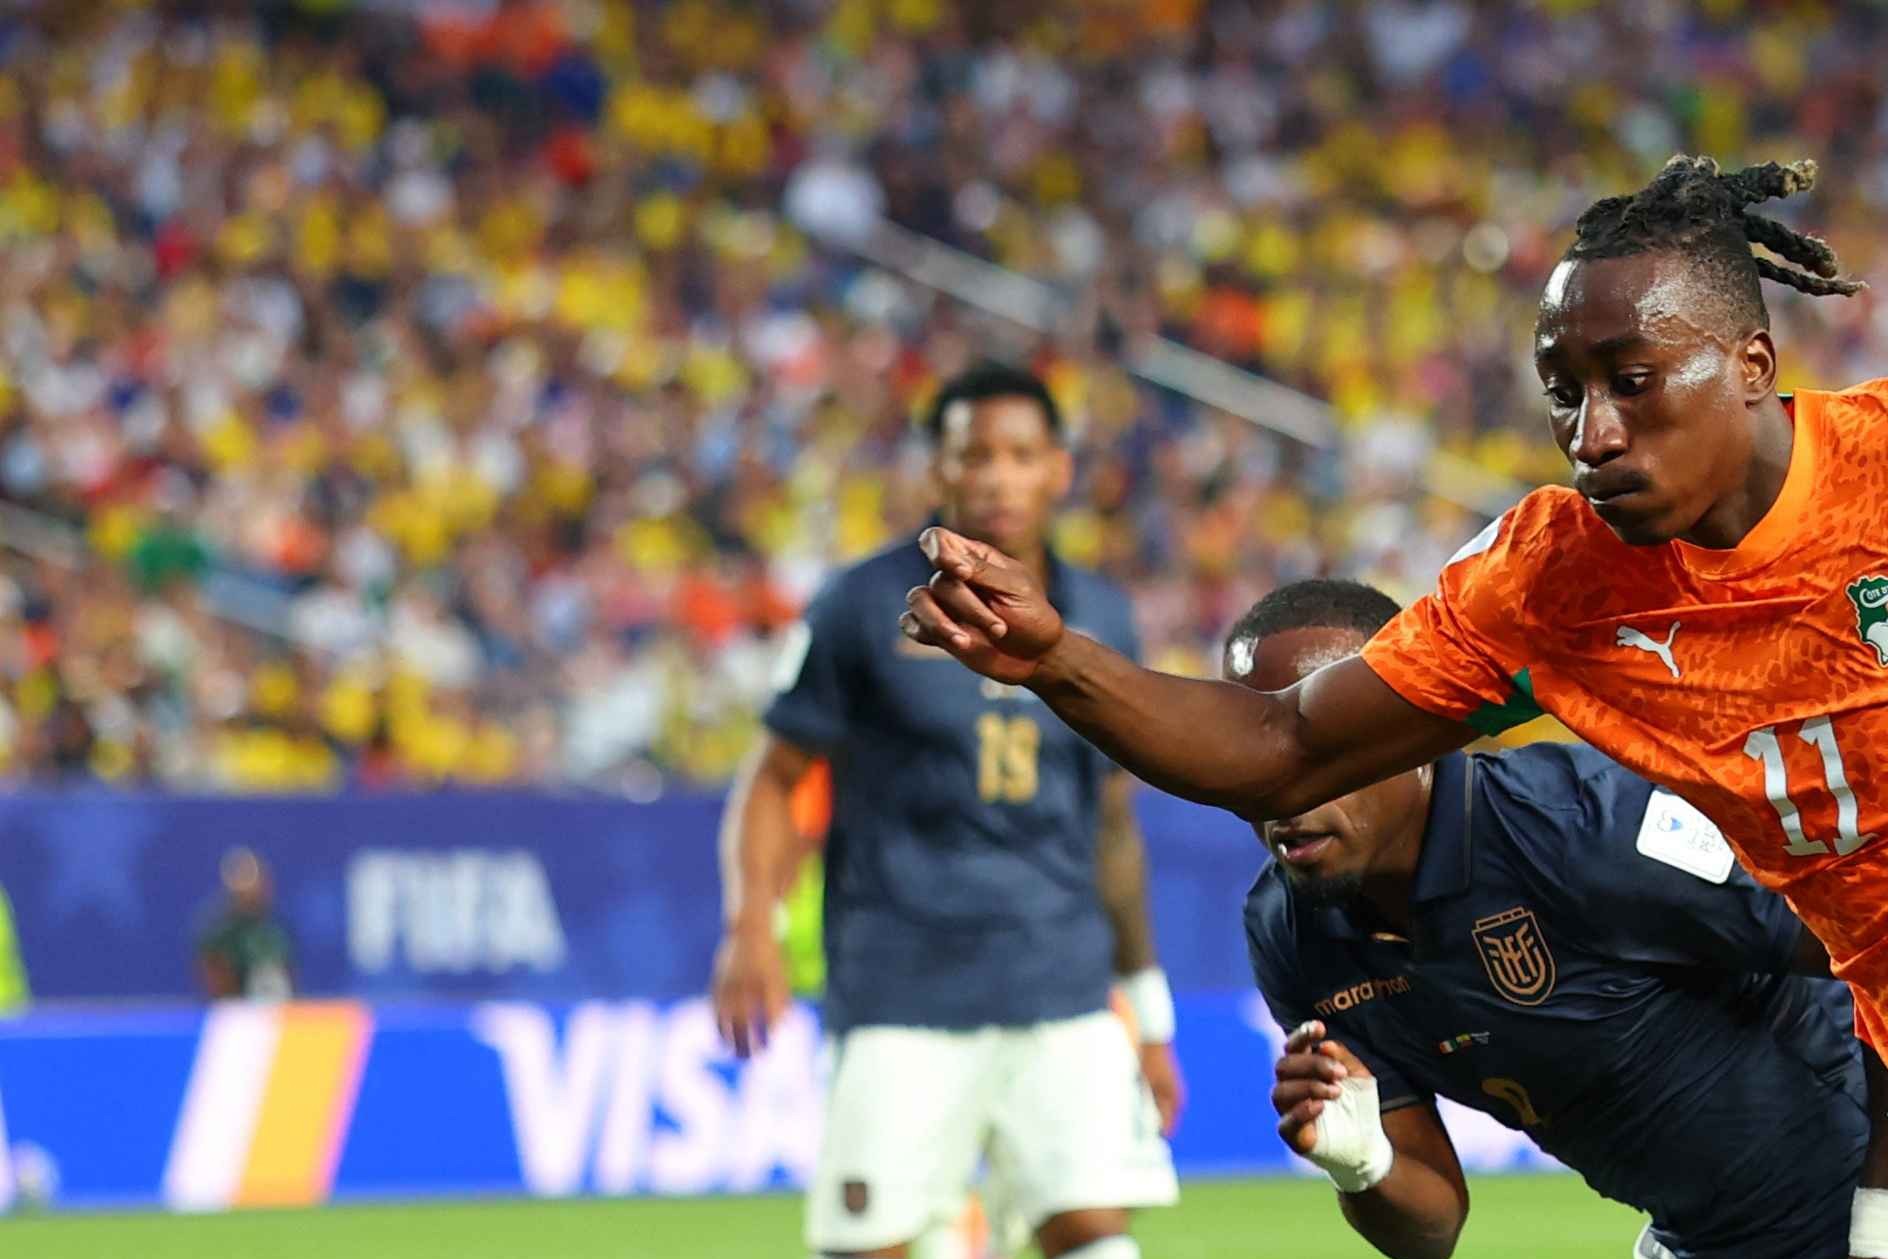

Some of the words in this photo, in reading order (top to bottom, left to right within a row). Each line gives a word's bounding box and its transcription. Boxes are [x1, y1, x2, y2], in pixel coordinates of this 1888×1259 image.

[1743, 714, 1881, 857] 11
[345, 847, 568, 974] FIFA
[1313, 976, 1412, 1017] marahon
[472, 1001, 828, 1197] VISA
